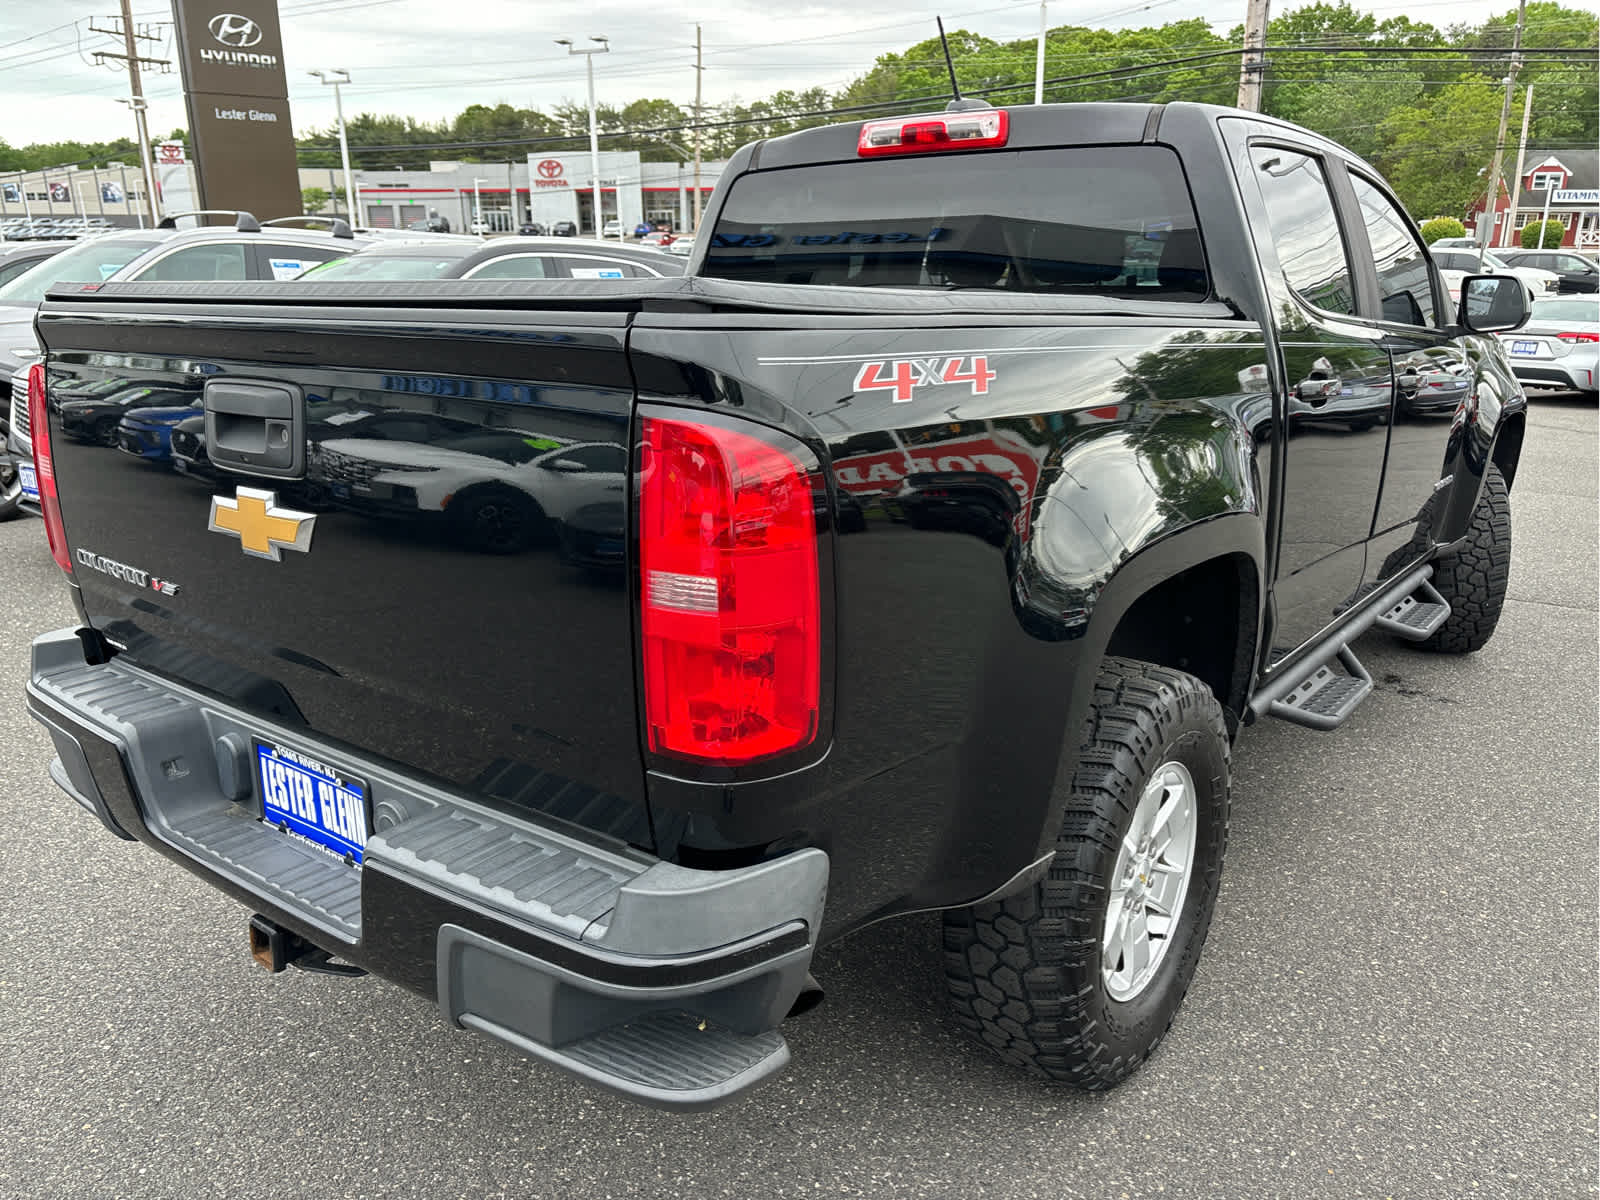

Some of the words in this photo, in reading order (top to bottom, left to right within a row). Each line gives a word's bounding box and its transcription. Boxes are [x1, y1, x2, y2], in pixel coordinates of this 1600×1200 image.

[200, 48, 277, 65] HYUNDAI
[215, 107, 247, 120] Lester
[249, 109, 277, 122] Glenn
[535, 179, 568, 187] TOYOTA
[77, 548, 147, 587] COLORADO
[275, 744, 298, 763] TOMS
[324, 766, 336, 780] NJ
[261, 757, 317, 824] LESTER
[318, 780, 367, 848] GLENN
